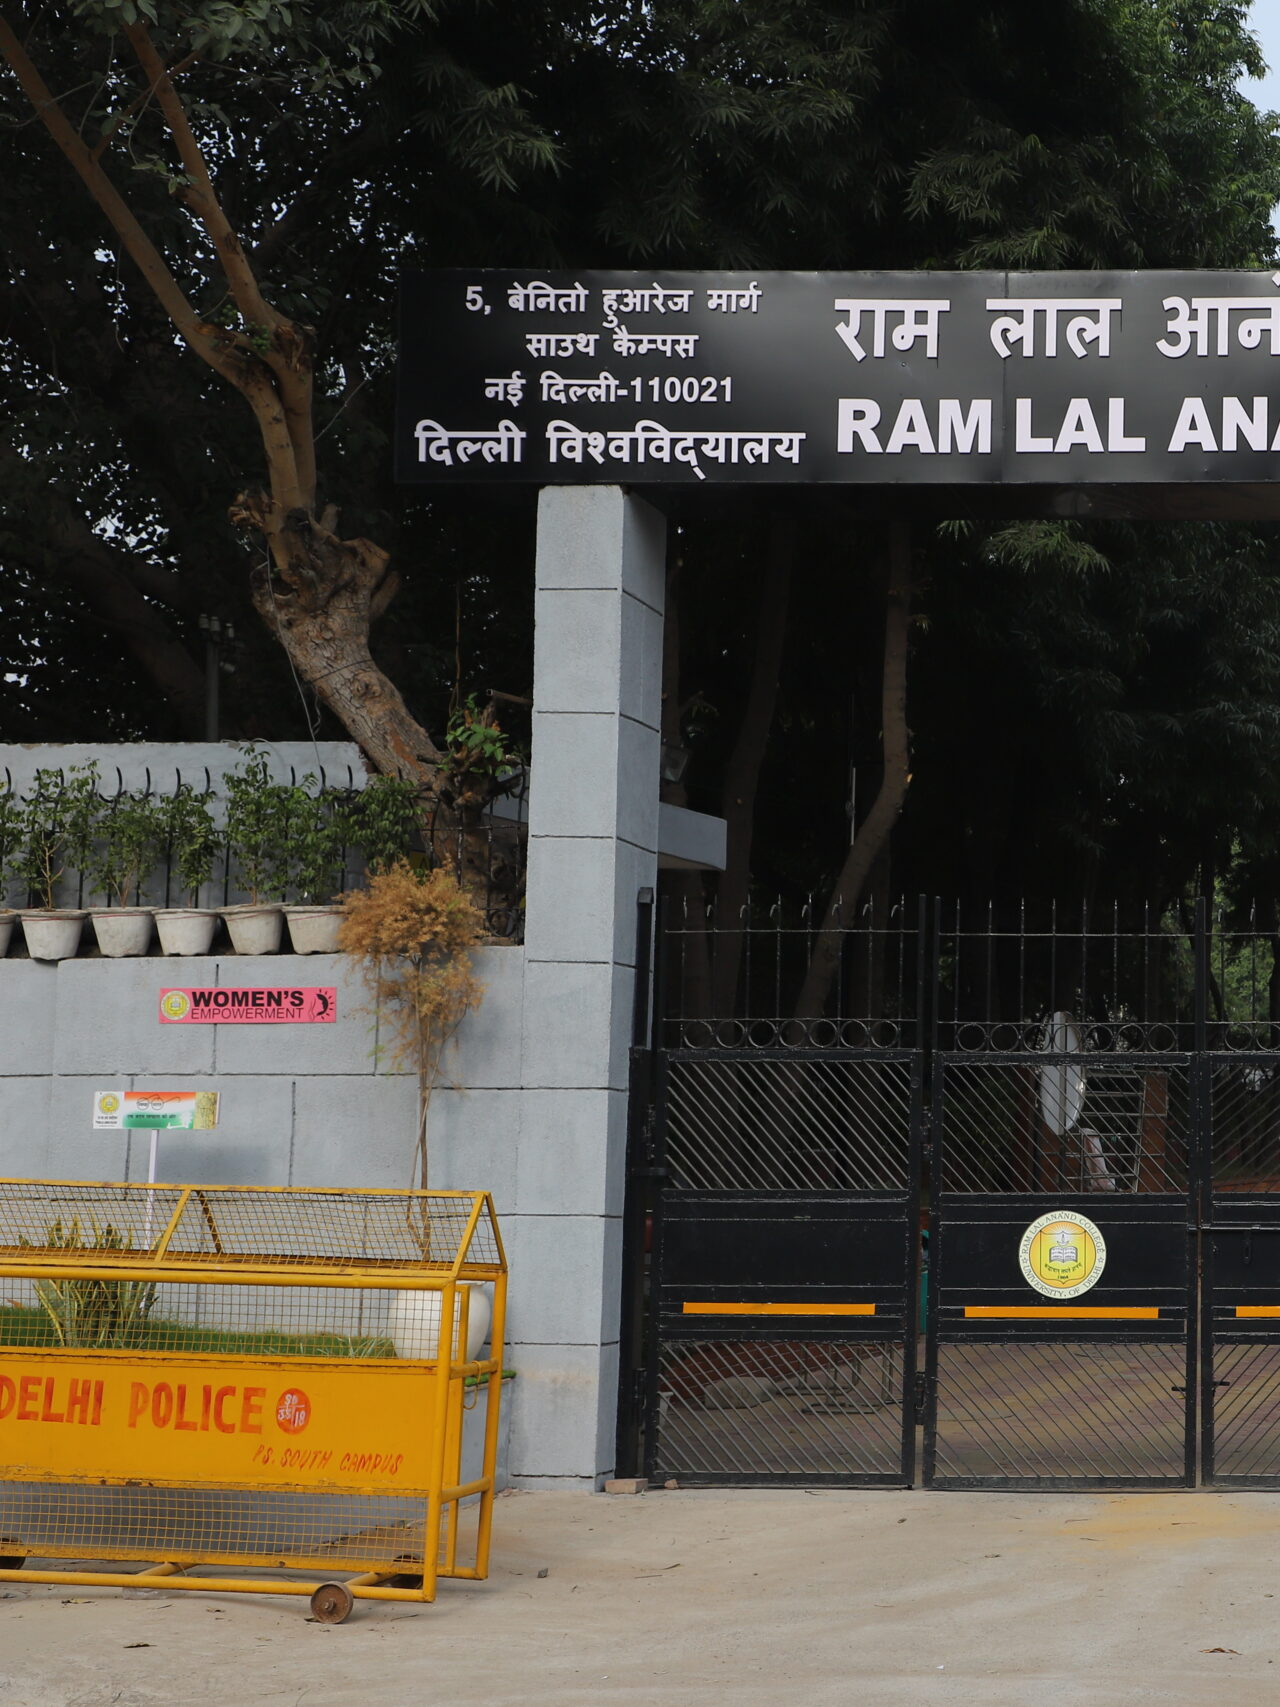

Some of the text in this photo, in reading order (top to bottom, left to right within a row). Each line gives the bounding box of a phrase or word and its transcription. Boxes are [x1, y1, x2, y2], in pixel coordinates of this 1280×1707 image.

[508, 282, 588, 312] बेनितो
[603, 283, 693, 328] हुआरेज
[707, 281, 762, 312] मार्ग
[526, 325, 699, 358] साउथ कैम्पस
[835, 299, 950, 361] राम
[986, 299, 1121, 359] लाल
[486, 371, 732, 406] नई दिल्ली-110021
[838, 399, 992, 453] RAM
[1016, 398, 1146, 453] LAL
[415, 420, 806, 479] दिल्ली विश्वविद्यालय
[191, 990, 304, 1008] WOMEN'S
[191, 1007, 304, 1020] EMPOWERMENT
[1021, 1235, 1032, 1254] RAM
[1030, 1221, 1044, 1235] LAL
[1045, 1212, 1077, 1223] ANAND
[1078, 1218, 1104, 1254] COLLEGE
[1068, 1288, 1081, 1297] OF
[1084, 1267, 1103, 1288] DELHI
[0, 1374, 267, 1435] DELHI POLICE
[280, 1447, 333, 1471] SOUTH
[339, 1452, 404, 1476] CAMPUS
